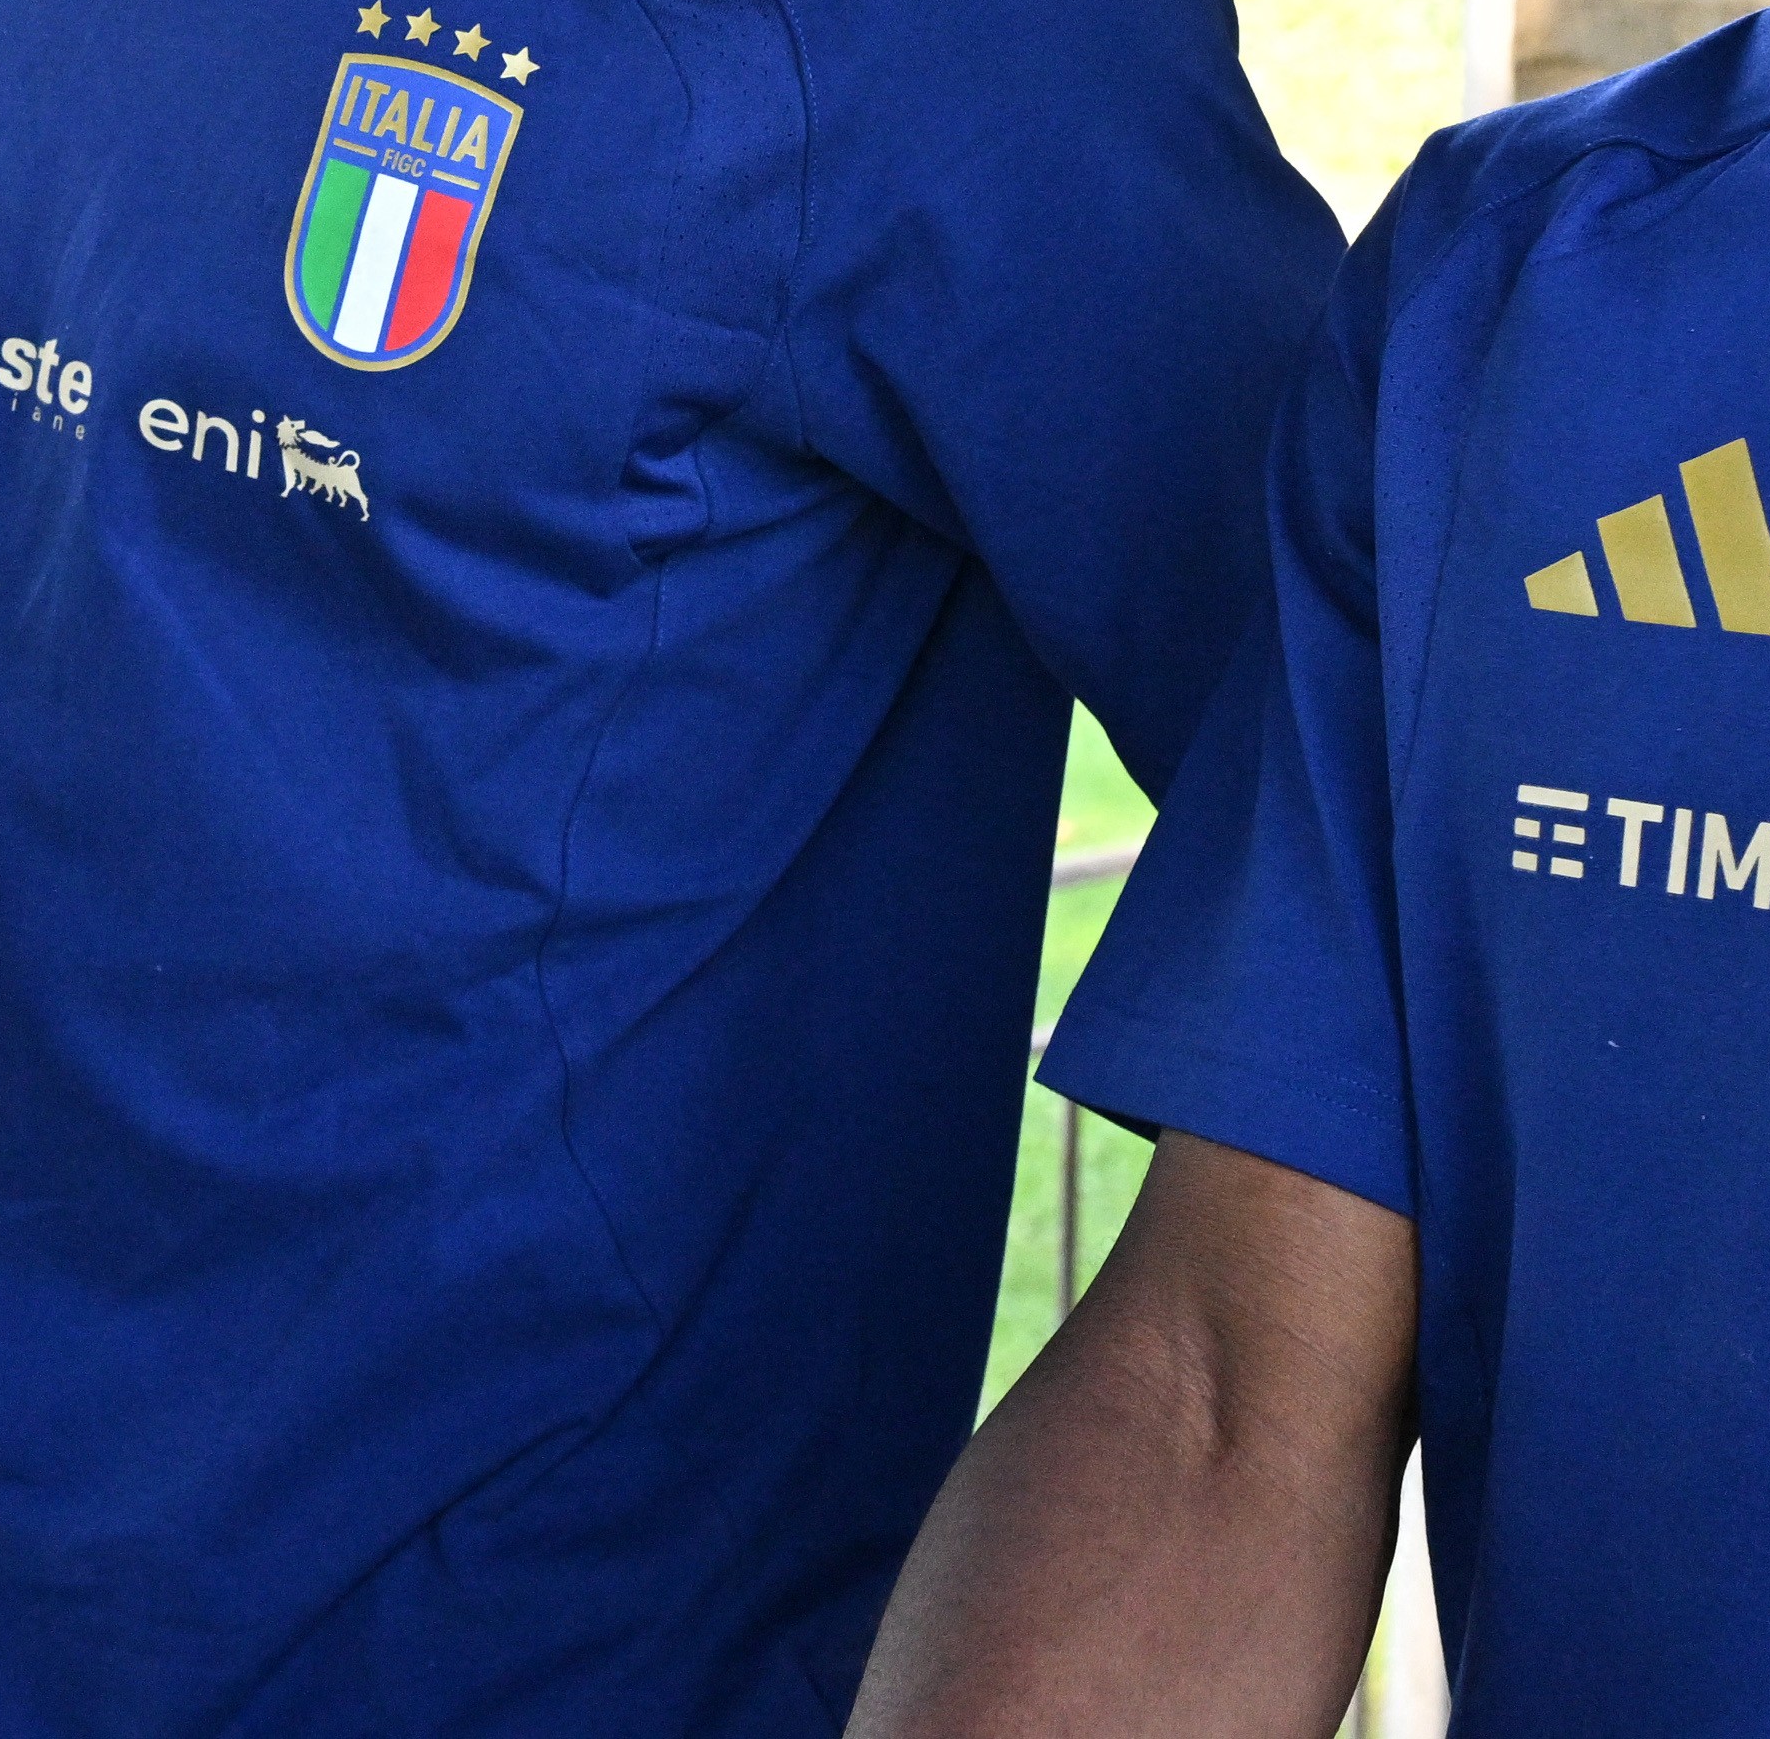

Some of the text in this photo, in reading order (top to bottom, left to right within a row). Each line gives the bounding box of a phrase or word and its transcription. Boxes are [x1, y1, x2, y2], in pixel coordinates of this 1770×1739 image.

[338, 74, 489, 171] ITALIA
[381, 147, 427, 178] FIGC
[138, 398, 266, 480] eni
